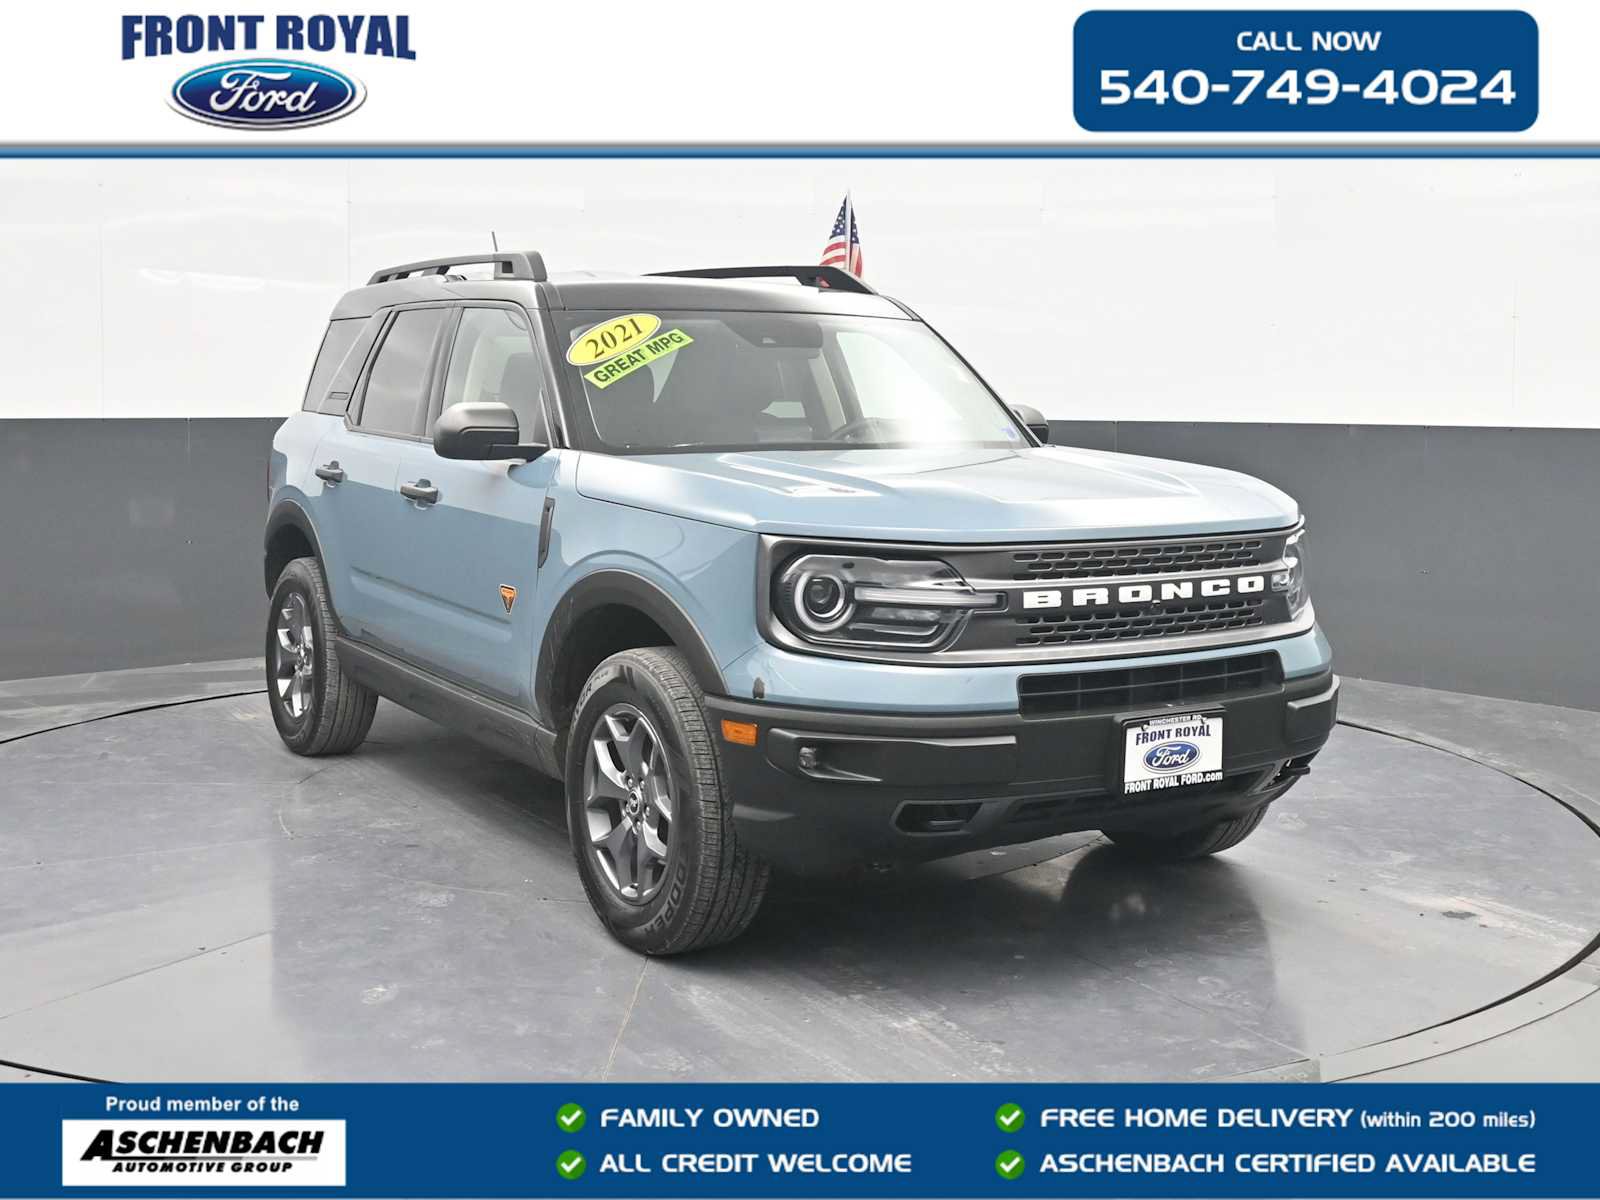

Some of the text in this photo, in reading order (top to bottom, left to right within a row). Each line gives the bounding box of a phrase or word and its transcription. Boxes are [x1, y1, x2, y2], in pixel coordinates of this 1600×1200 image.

[585, 318, 643, 359] 2021
[593, 332, 684, 383] GREAT MPG
[1022, 575, 1265, 609] BRONCO
[1135, 724, 1212, 746] FRONT ROYAL
[1151, 745, 1191, 767] Ford
[1124, 771, 1223, 795] FRONT ROYAL FORD.com
